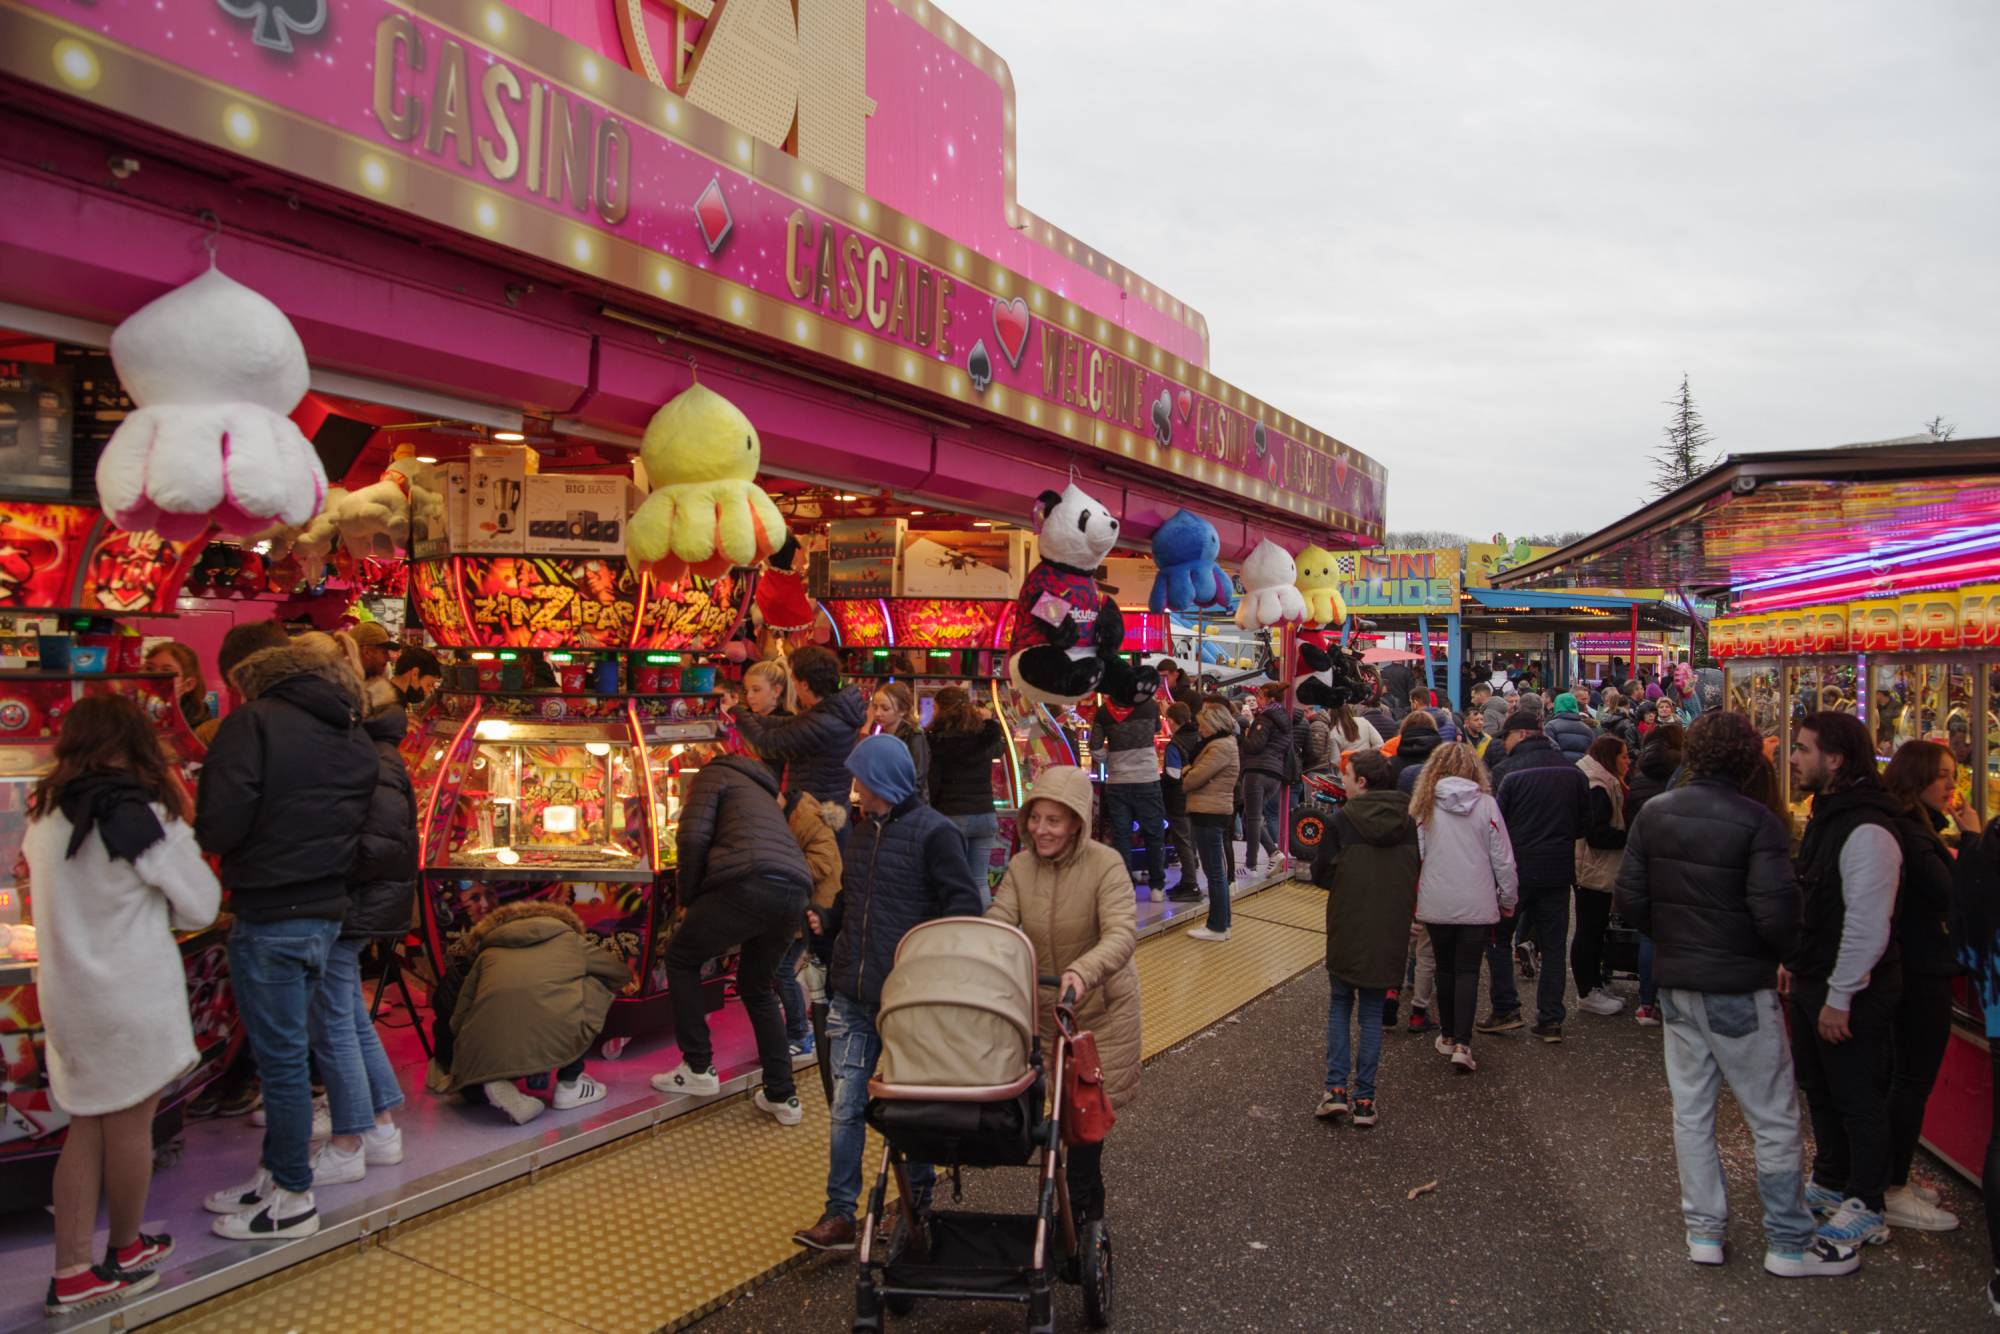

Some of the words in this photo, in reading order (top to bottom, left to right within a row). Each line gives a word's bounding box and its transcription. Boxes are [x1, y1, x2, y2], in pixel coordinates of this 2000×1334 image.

[372, 13, 631, 225] CASINO
[786, 208, 956, 356] CASCADE
[1040, 324, 1145, 430] WELCOME
[564, 484, 586, 494] BIG
[1360, 552, 1436, 579] MINI
[1340, 579, 1453, 606] OLIDE
[473, 583, 635, 632] ZANZIBAR
